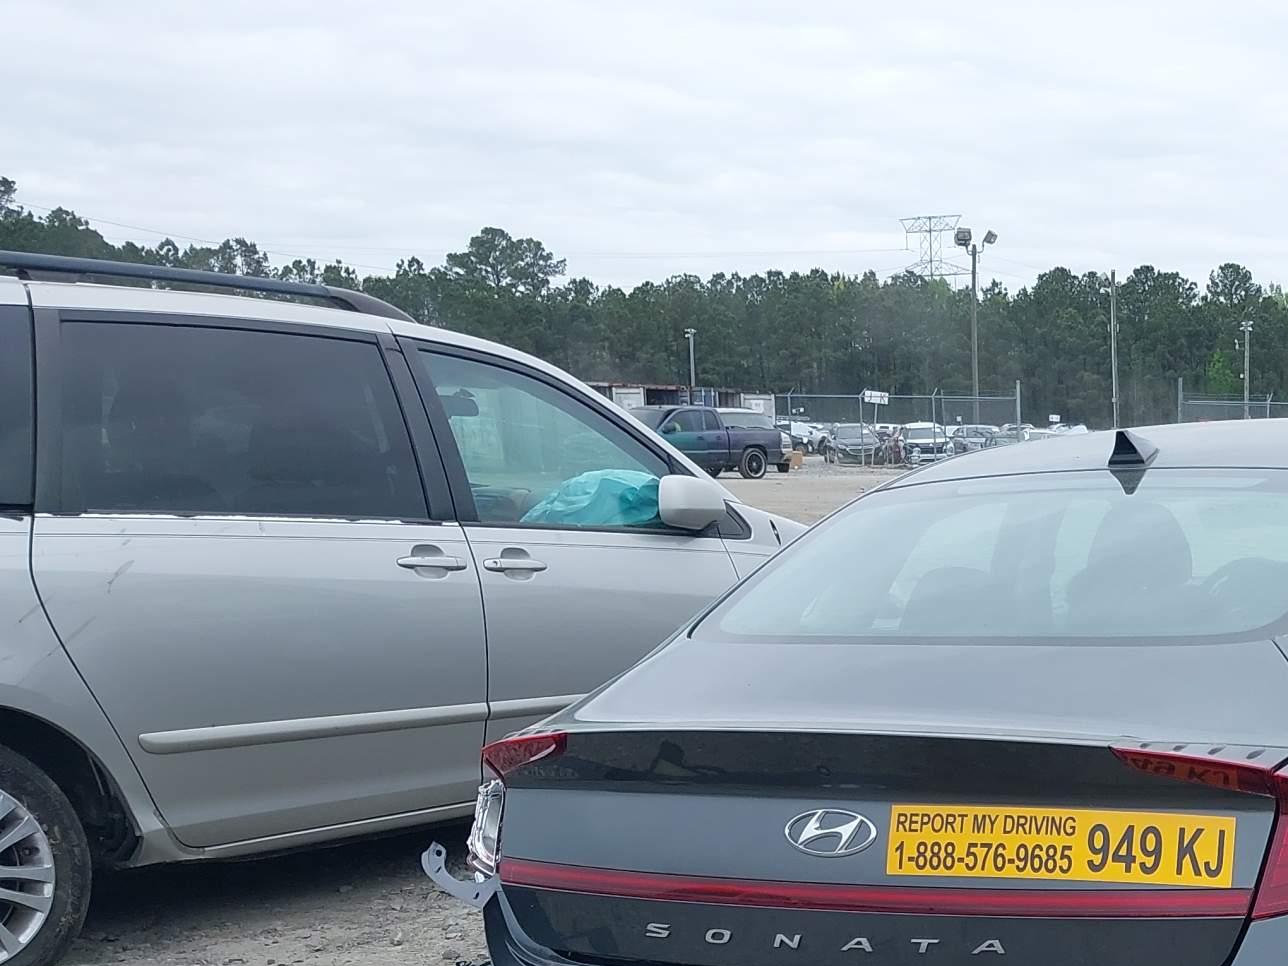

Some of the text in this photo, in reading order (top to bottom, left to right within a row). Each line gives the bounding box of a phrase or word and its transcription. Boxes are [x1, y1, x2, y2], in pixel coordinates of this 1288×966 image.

[895, 812, 1077, 837] REPORT MY DRIVING
[893, 840, 1074, 875] 1-888-576-9685
[1086, 824, 1226, 879] 949 KJ
[644, 922, 1007, 955] SONATA
